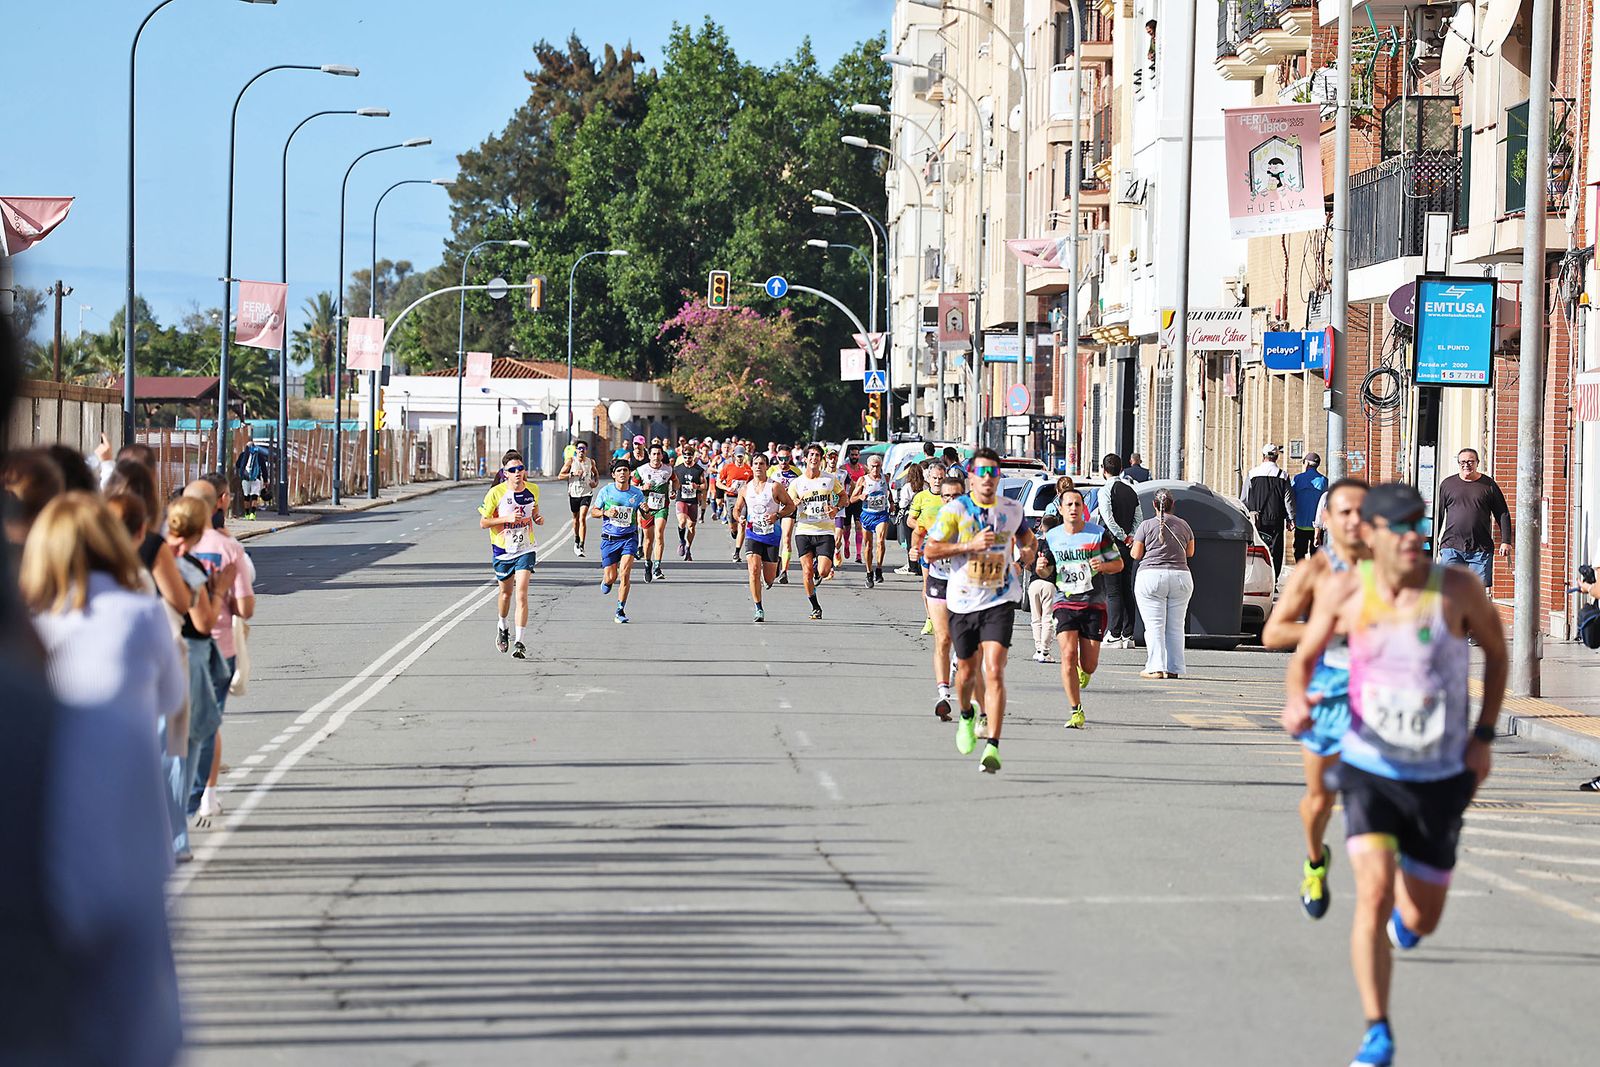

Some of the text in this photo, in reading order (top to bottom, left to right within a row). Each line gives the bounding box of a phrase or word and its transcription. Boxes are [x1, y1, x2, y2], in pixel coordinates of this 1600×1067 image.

[1240, 114, 1269, 125] FERIA
[1259, 121, 1288, 133] LIBRO
[1247, 199, 1306, 213] HUELVA
[1434, 242, 1441, 256] 7
[243, 301, 272, 313] FERIA
[1425, 302, 1486, 313] EMTUSA
[1192, 327, 1221, 345] Carmen
[1267, 346, 1294, 356] pelayo
[512, 534, 524, 542] 29
[1065, 571, 1085, 583] 230
